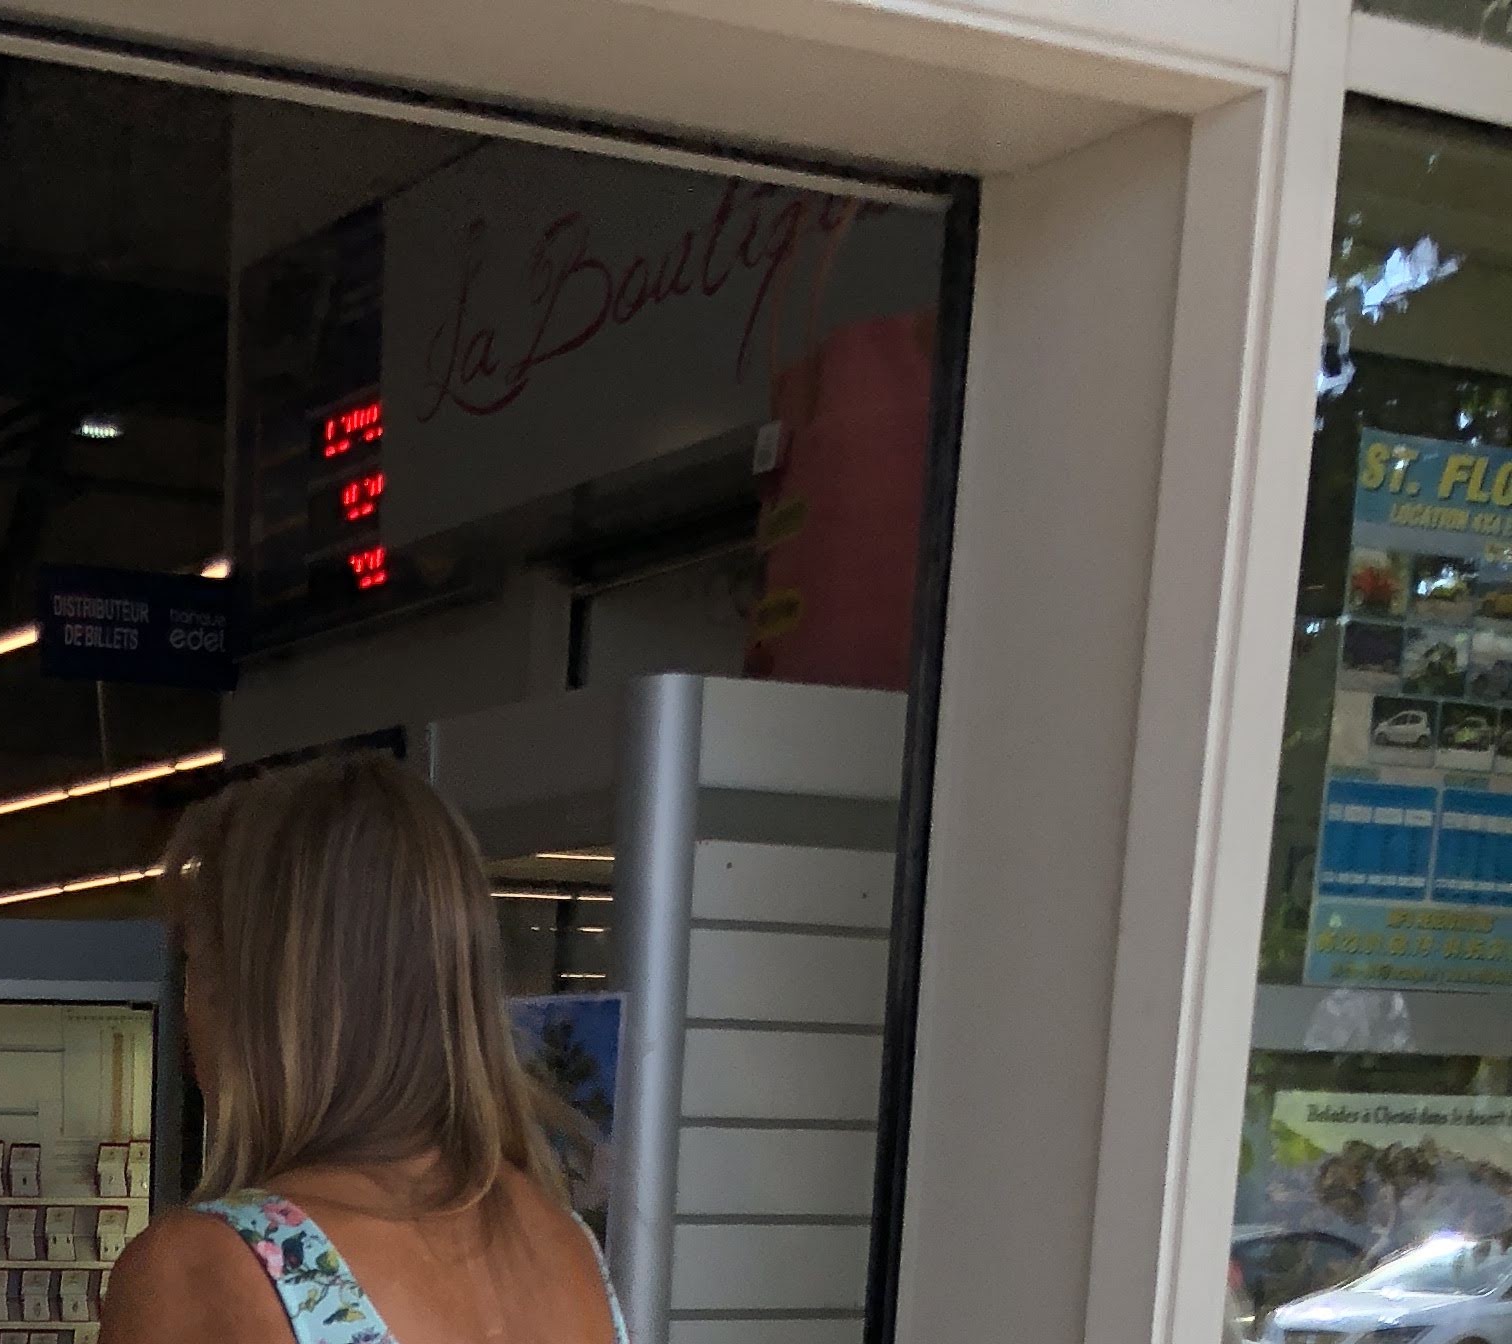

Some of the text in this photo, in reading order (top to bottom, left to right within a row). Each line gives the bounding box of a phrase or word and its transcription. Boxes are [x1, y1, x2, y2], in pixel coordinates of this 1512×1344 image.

[1360, 443, 1421, 496] ST.
[53, 594, 150, 624] DISTRIBUTEUR
[64, 623, 139, 650] DE BILLETS
